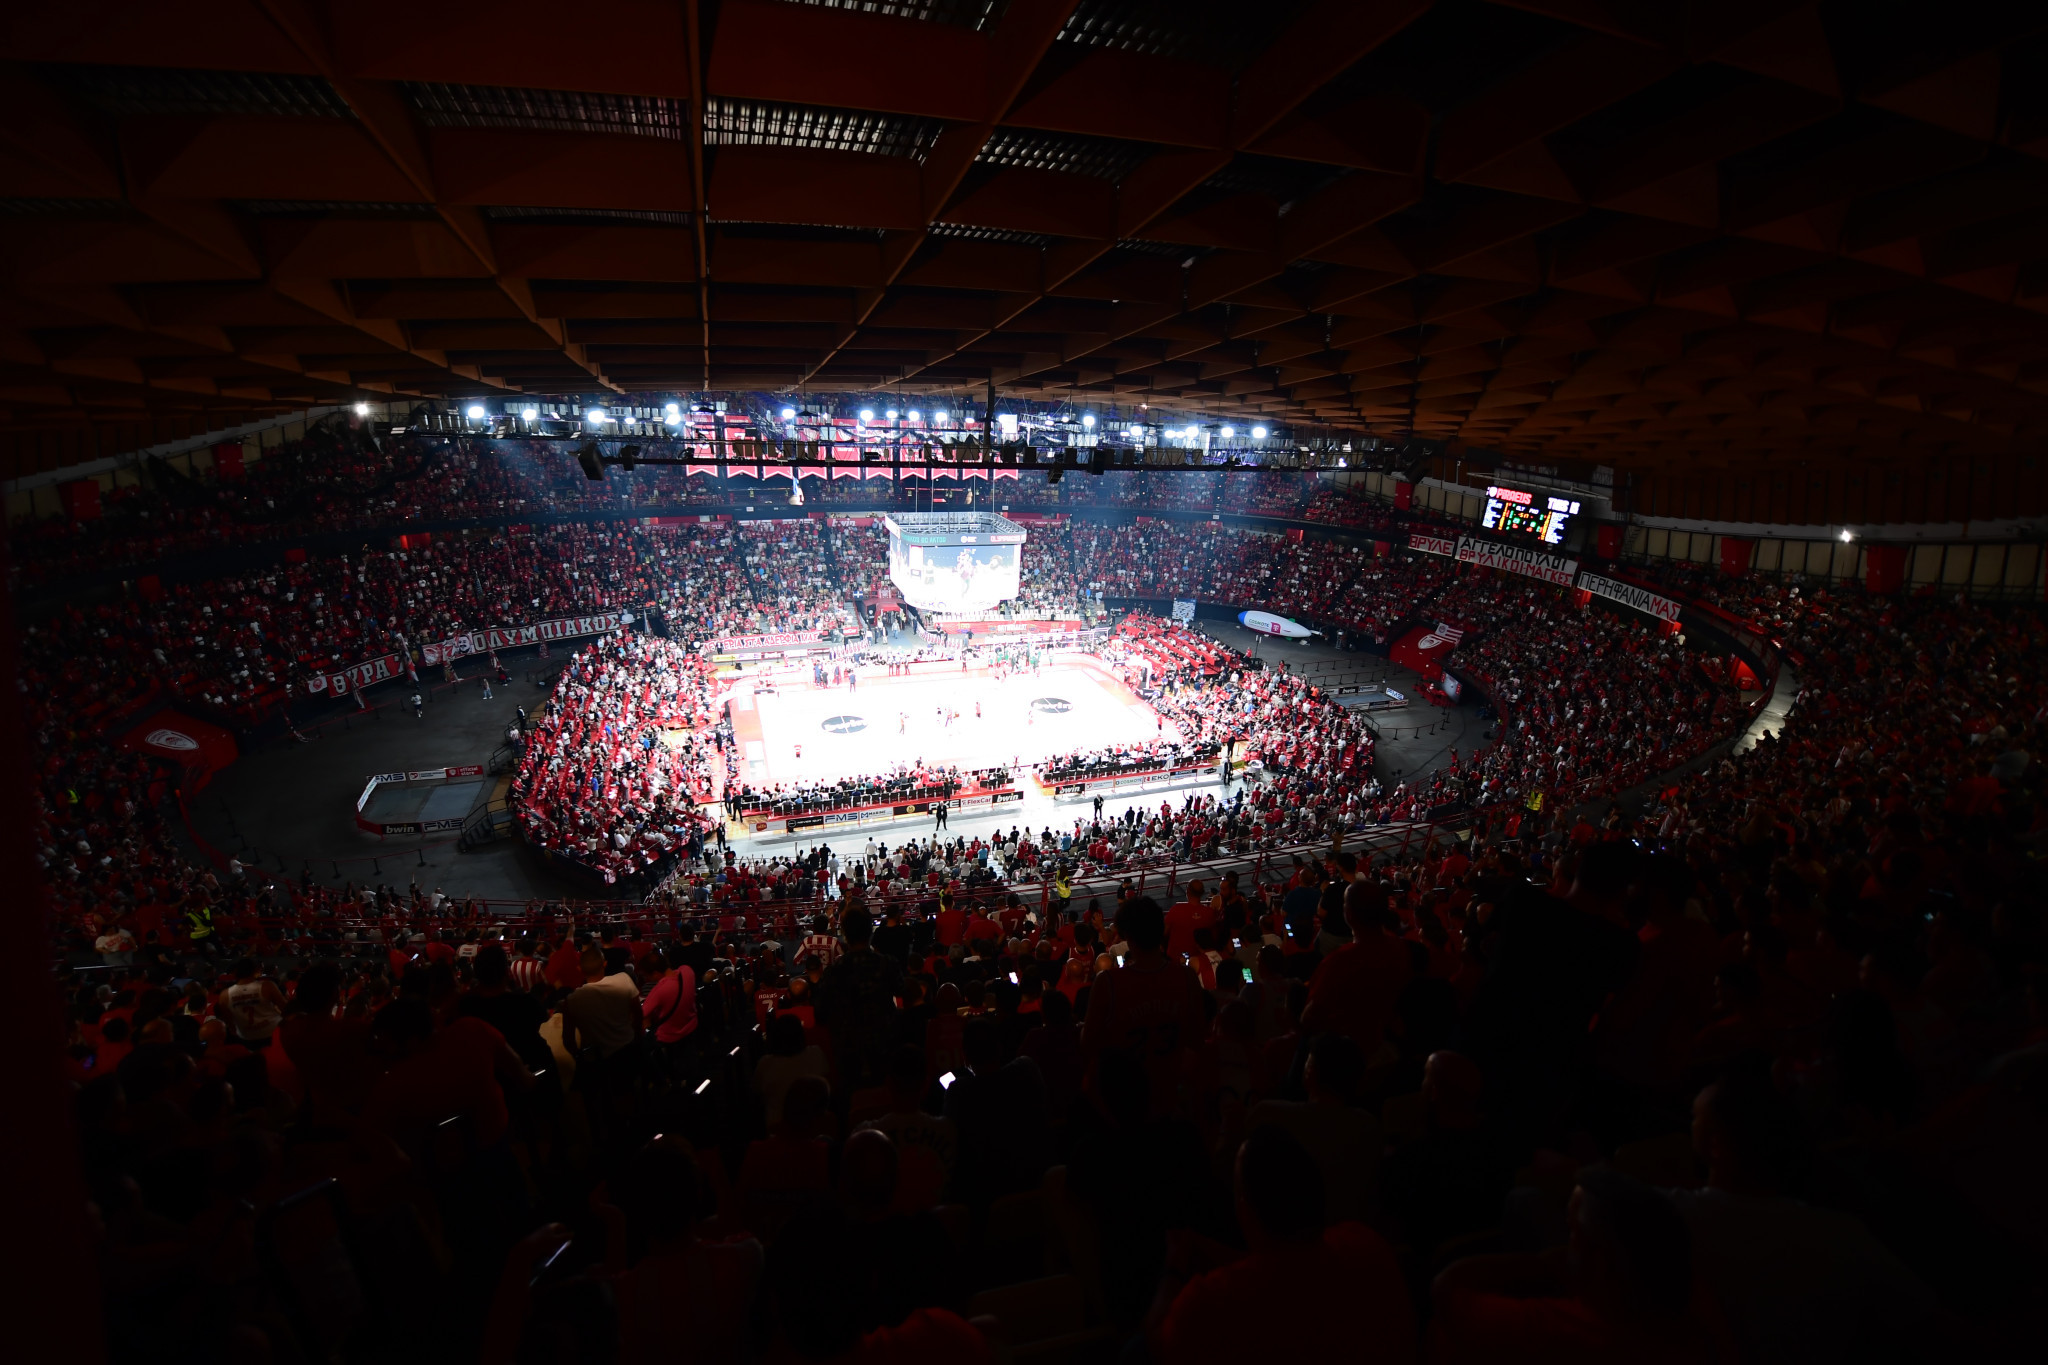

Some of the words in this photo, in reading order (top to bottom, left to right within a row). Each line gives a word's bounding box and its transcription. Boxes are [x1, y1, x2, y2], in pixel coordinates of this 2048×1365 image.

[1496, 488, 1532, 505] PIRAEUS
[1460, 537, 1567, 571] ΑΓΓΕΛΟΠΟΥΛΟΙ
[1649, 596, 1681, 622] ΜΑΣ
[1249, 618, 1270, 628] COSMOTE
[472, 614, 620, 651] ΟΛΥΜΠΙΑΚΟΣ
[745, 636, 763, 649] ΣΤΑ
[764, 633, 799, 646] ΑΔΕΡΦΙΑ
[801, 631, 819, 643] ΜΑΣ
[1059, 784, 1081, 794] bwin
[967, 797, 991, 805] FlexCar
[996, 792, 1019, 803] bwin
[824, 812, 858, 823] FMS
[386, 823, 415, 834] bwin
[424, 819, 464, 831] FMS
